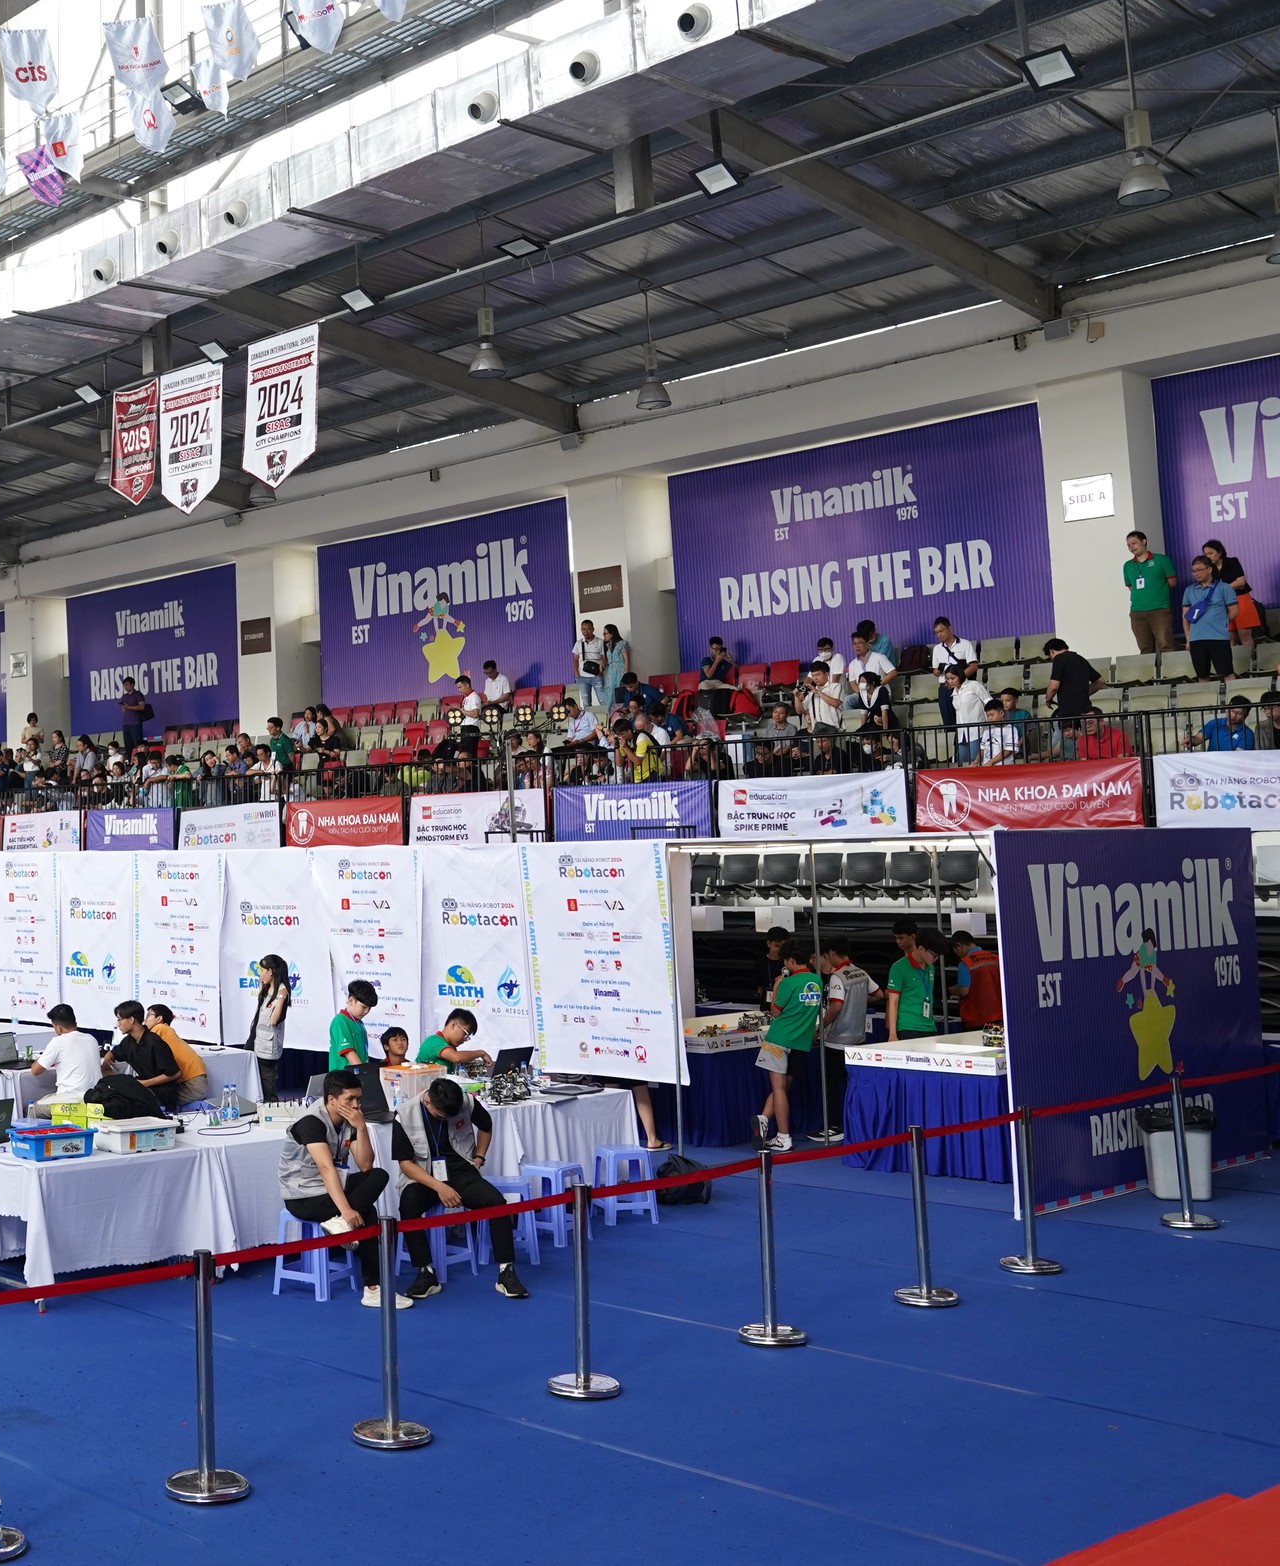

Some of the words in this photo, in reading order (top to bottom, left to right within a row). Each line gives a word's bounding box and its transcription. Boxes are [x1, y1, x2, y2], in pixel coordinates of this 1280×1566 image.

[251, 347, 269, 361] CANADIAN
[270, 340, 299, 356] INTERNATIONAL
[299, 335, 315, 348] SCHOOL
[280, 356, 310, 374] FOOTBALL
[257, 375, 304, 421] 2024
[170, 407, 213, 449] 2024
[265, 417, 292, 434] SISAC
[122, 426, 151, 454] 2019
[255, 435, 268, 447] CITY
[268, 428, 302, 444] CHAMPIONS
[179, 447, 201, 461] SISAC
[168, 463, 180, 474] CITY
[180, 458, 212, 471] CHAMPIONS
[770, 465, 917, 525] Vinamilk
[1069, 492, 1095, 505] SIDE
[1099, 491, 1106, 500] A
[1209, 491, 1248, 522] EST
[774, 527, 789, 541] EST
[896, 505, 918, 521] 1976
[349, 538, 533, 620] Vinamilk
[719, 560, 842, 621] RAISING
[847, 550, 914, 605] THE
[918, 539, 995, 596] BAR
[583, 584, 612, 596] STANDARD
[115, 601, 183, 638] Vinamilk
[352, 624, 370, 645] EST
[506, 599, 534, 622] 1976
[117, 637, 125, 647] EST
[174, 627, 185, 638] 1976
[90, 665, 148, 701] RAISING
[151, 658, 182, 691] THE
[184, 652, 218, 689] BAR
[1250, 777, 1280, 785] ROBOT
[978, 788, 1010, 801] NHA
[1014, 785, 1058, 800] KHOA
[1092, 781, 1131, 796] NAM
[584, 791, 679, 820] Vinamilk
[1170, 791, 1280, 811] Robotac
[105, 814, 157, 835] Vinamilk
[318, 816, 335, 826] NHA
[338, 815, 360, 825] KHOA
[379, 813, 399, 823] NAM
[585, 823, 595, 833] EST
[183, 833, 237, 846] Robotacon
[339, 870, 392, 880] Robotacon
[559, 866, 625, 878] Robotacon
[70, 909, 116, 920] Robotacon
[241, 913, 299, 925] Robotacon
[442, 911, 517, 927] Robotacon
[1027, 858, 1239, 962] Vinamilk
[66, 966, 94, 977] EARTH
[439, 983, 484, 998] EARTH
[1037, 973, 1062, 1008] EST
[1214, 955, 1241, 987] 1976
[906, 1055, 931, 1063] Vinamilk
